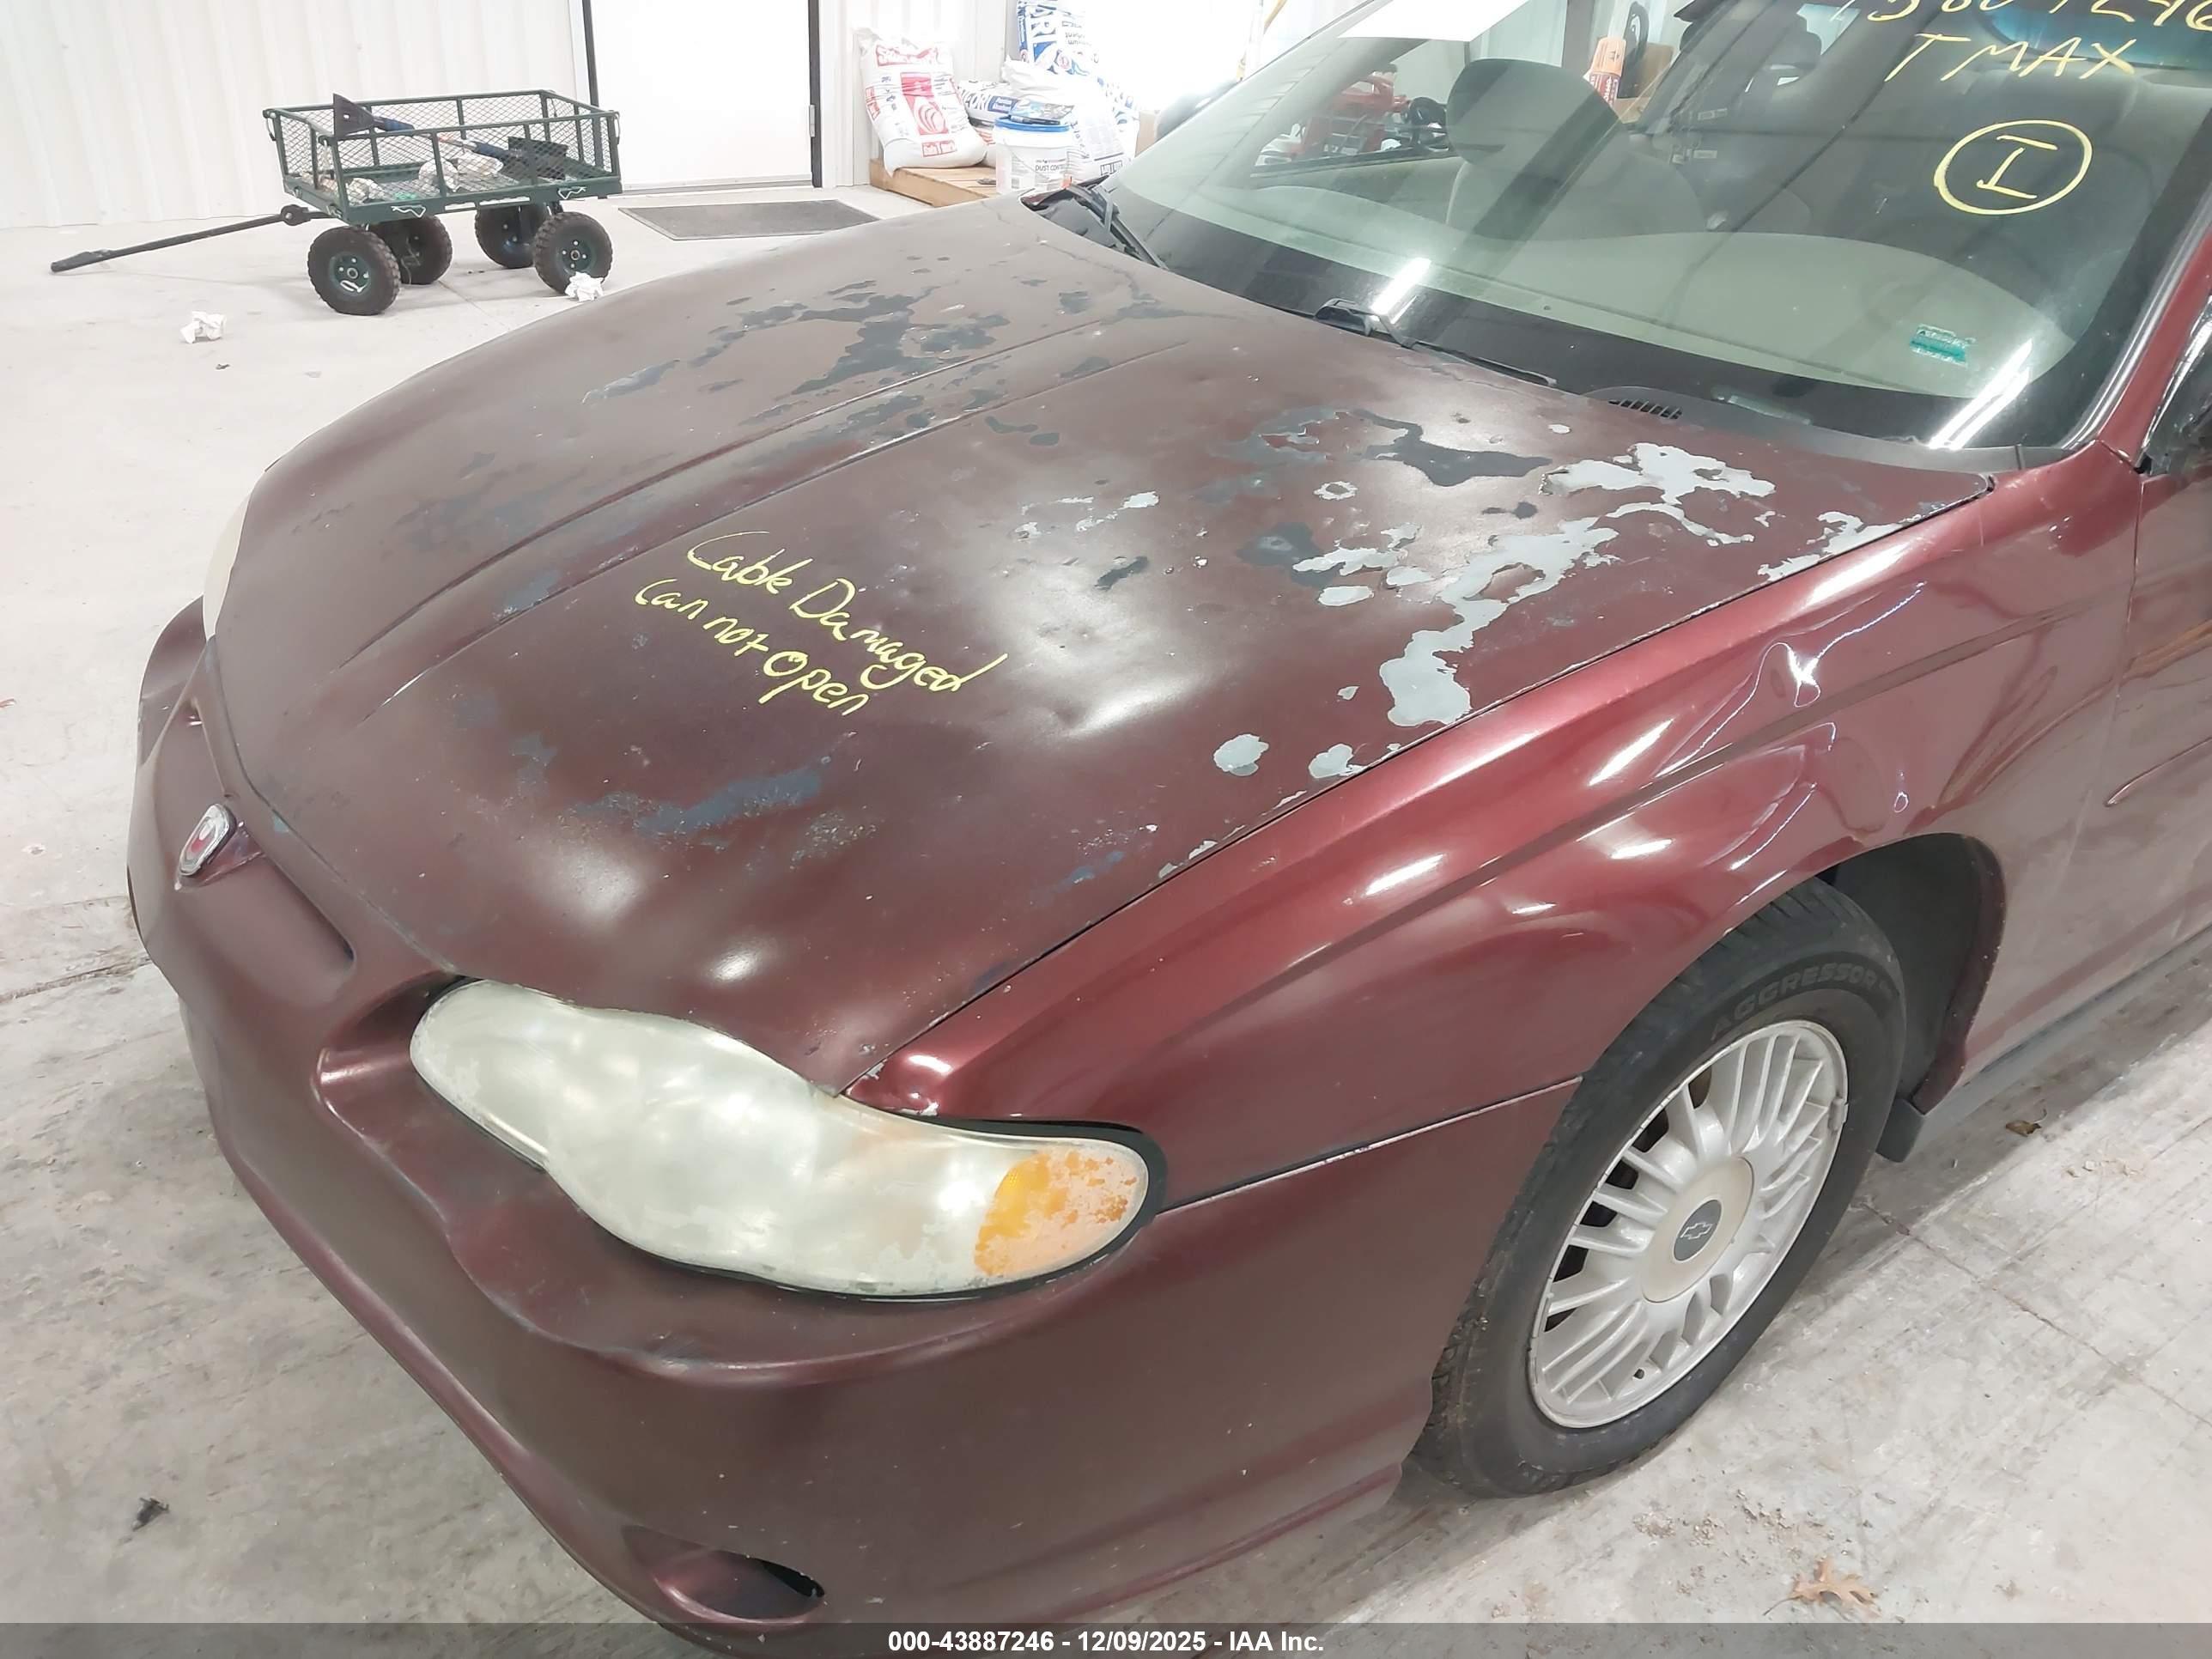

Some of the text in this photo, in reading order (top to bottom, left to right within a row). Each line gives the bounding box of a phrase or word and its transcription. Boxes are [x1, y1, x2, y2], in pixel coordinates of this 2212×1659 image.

[635, 578, 709, 620] Can
[702, 616, 770, 657] not
[687, 530, 1009, 692] Cable Damaged
